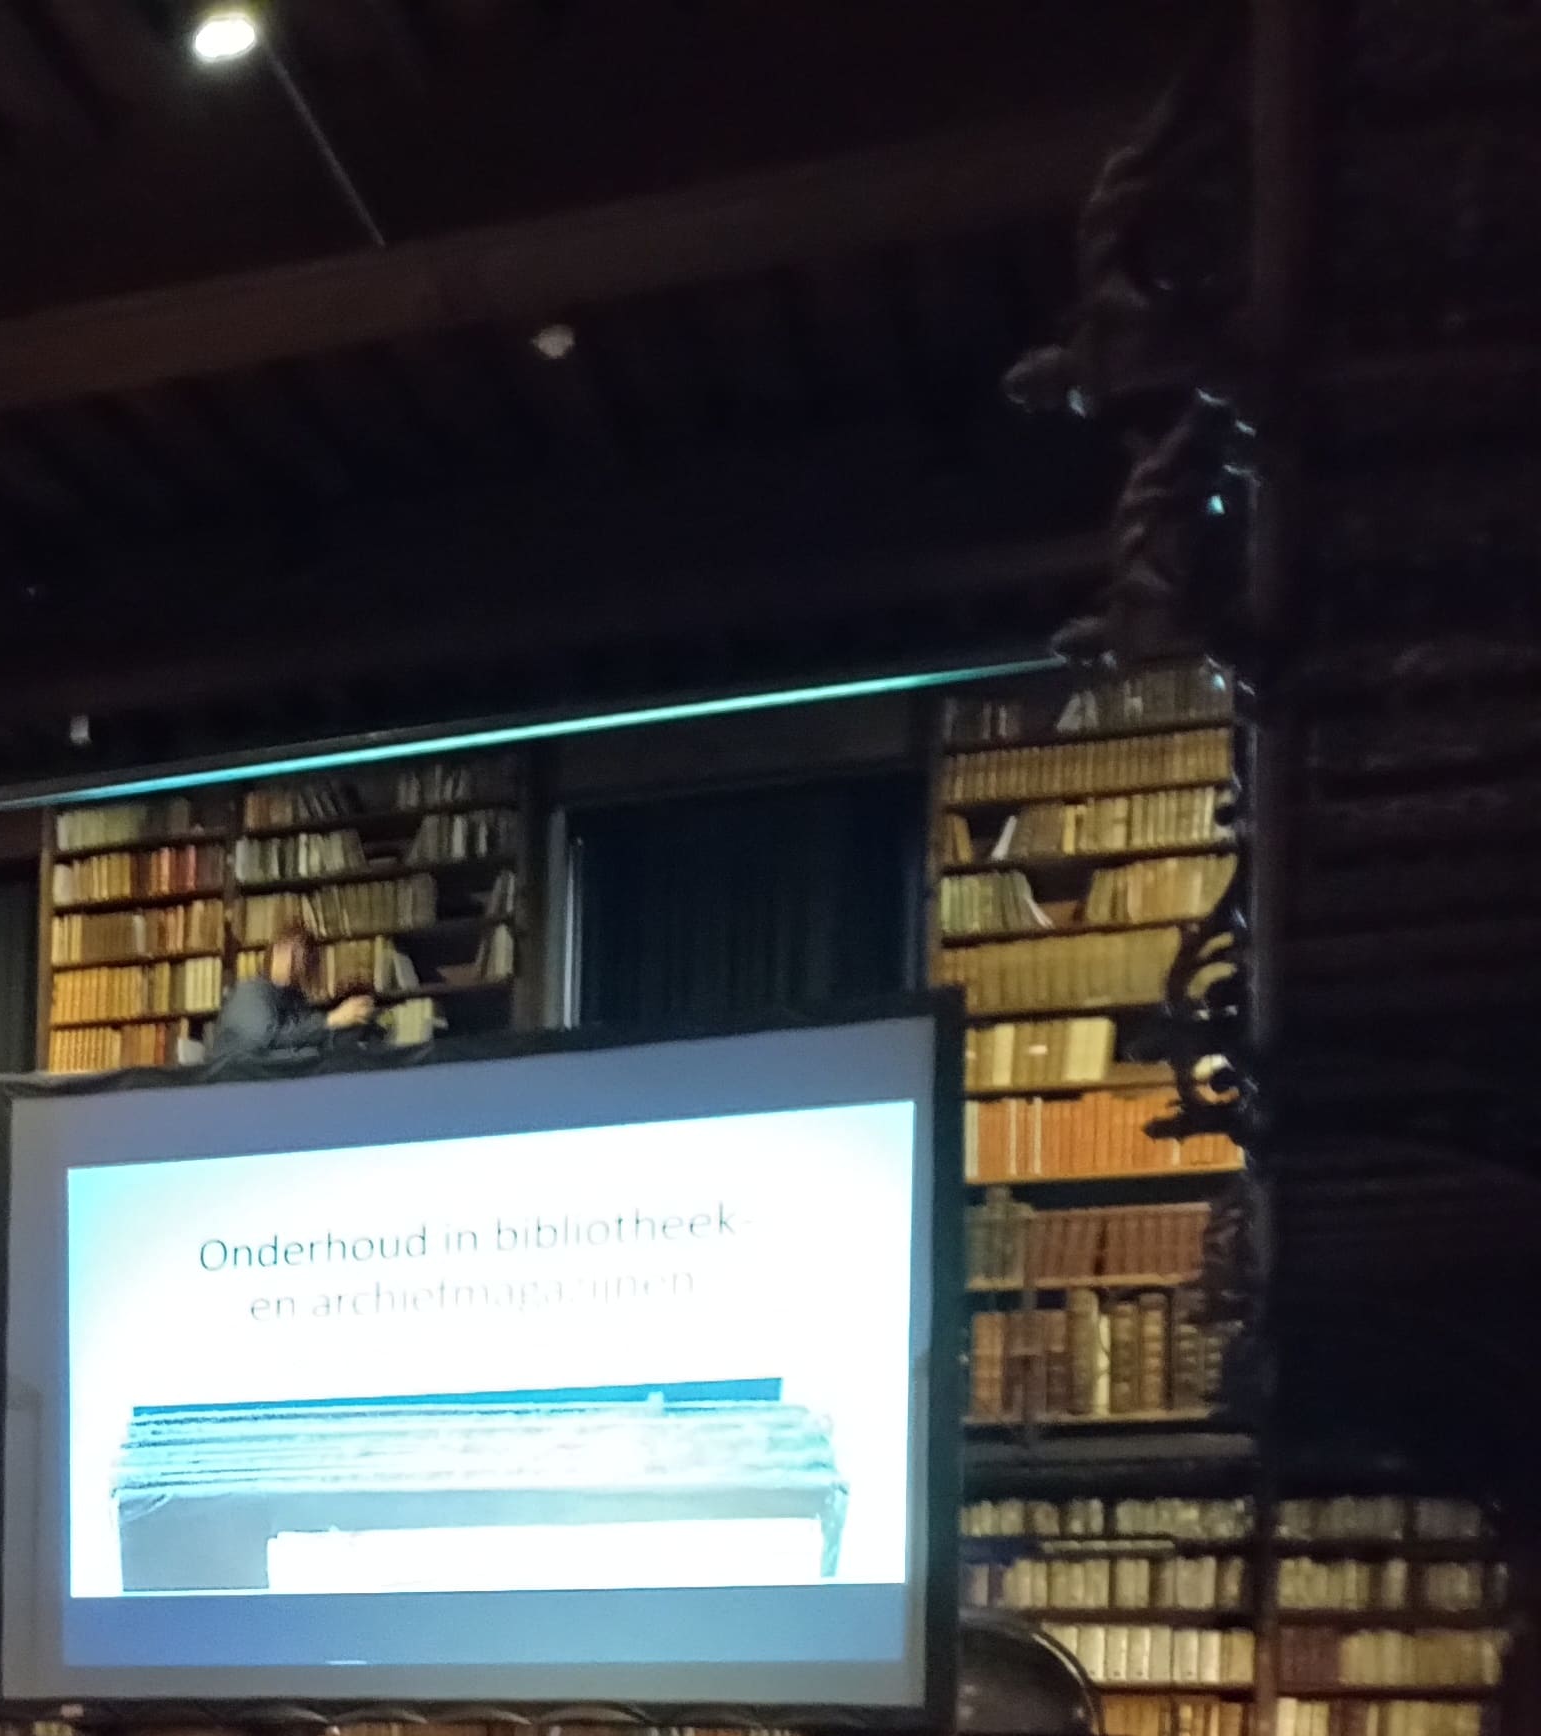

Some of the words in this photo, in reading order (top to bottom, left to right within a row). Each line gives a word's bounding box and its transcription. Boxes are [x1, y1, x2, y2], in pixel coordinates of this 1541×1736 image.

[199, 1222, 427, 1272] Onderhoud
[444, 1223, 478, 1254] in
[249, 1295, 296, 1321] en
[311, 1270, 695, 1318] archiefmagaijnen
